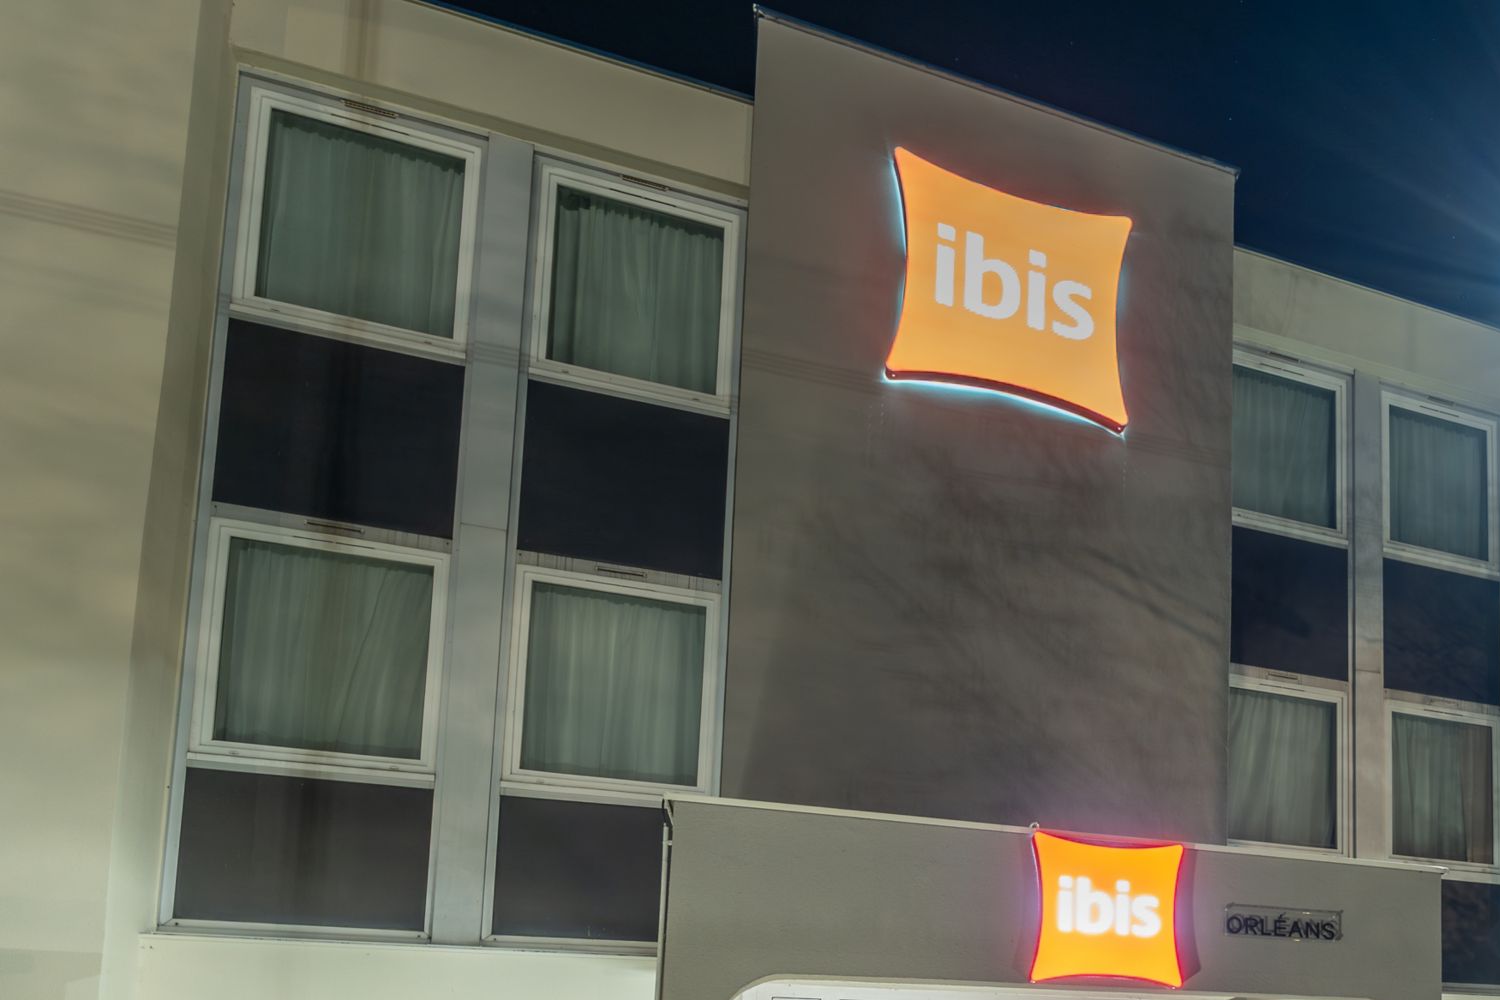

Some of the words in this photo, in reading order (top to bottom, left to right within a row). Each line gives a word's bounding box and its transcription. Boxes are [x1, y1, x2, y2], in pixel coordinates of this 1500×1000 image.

[935, 222, 1094, 340] ibis
[1055, 874, 1163, 939] ibis
[1226, 912, 1336, 940] ORLÉANS
